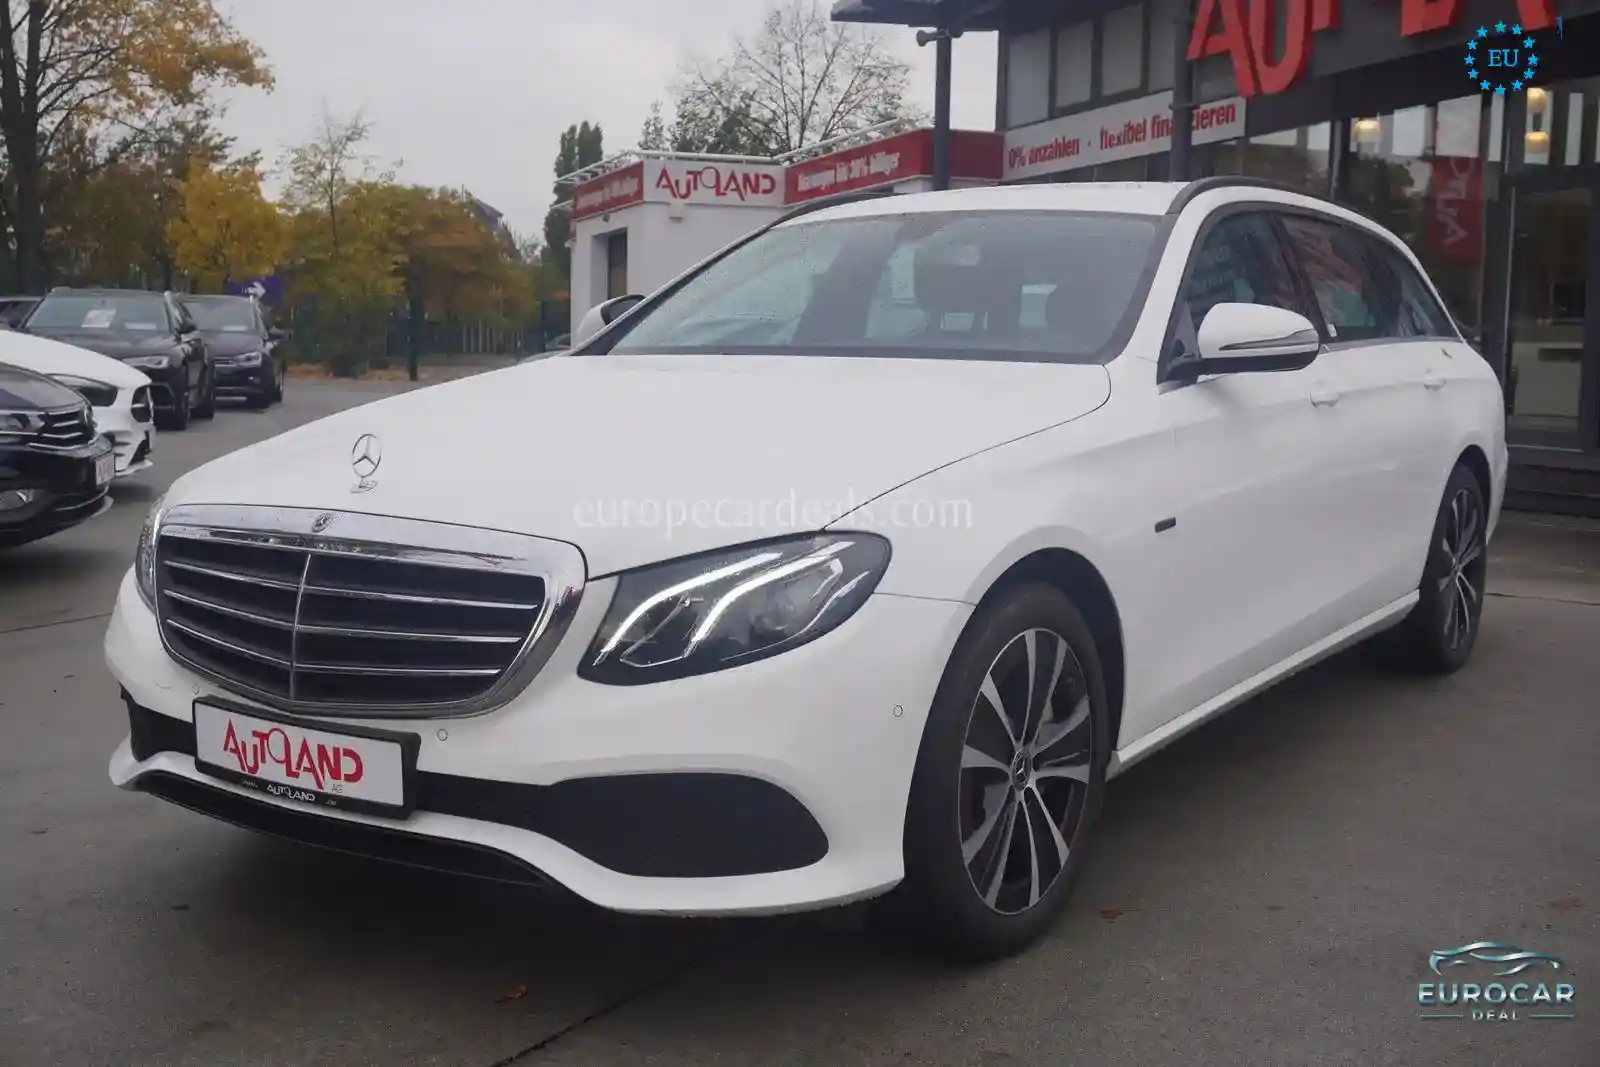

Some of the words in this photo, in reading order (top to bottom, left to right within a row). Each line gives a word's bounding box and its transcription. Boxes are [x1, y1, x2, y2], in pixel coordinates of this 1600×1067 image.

[1009, 148, 1025, 169] 0%
[1028, 135, 1080, 165] anzahlen
[1100, 117, 1147, 151] flexibel
[656, 165, 776, 201] AUTOLAND
[223, 718, 363, 791] AUTOLAND
[267, 783, 315, 802] AUTOLAND
